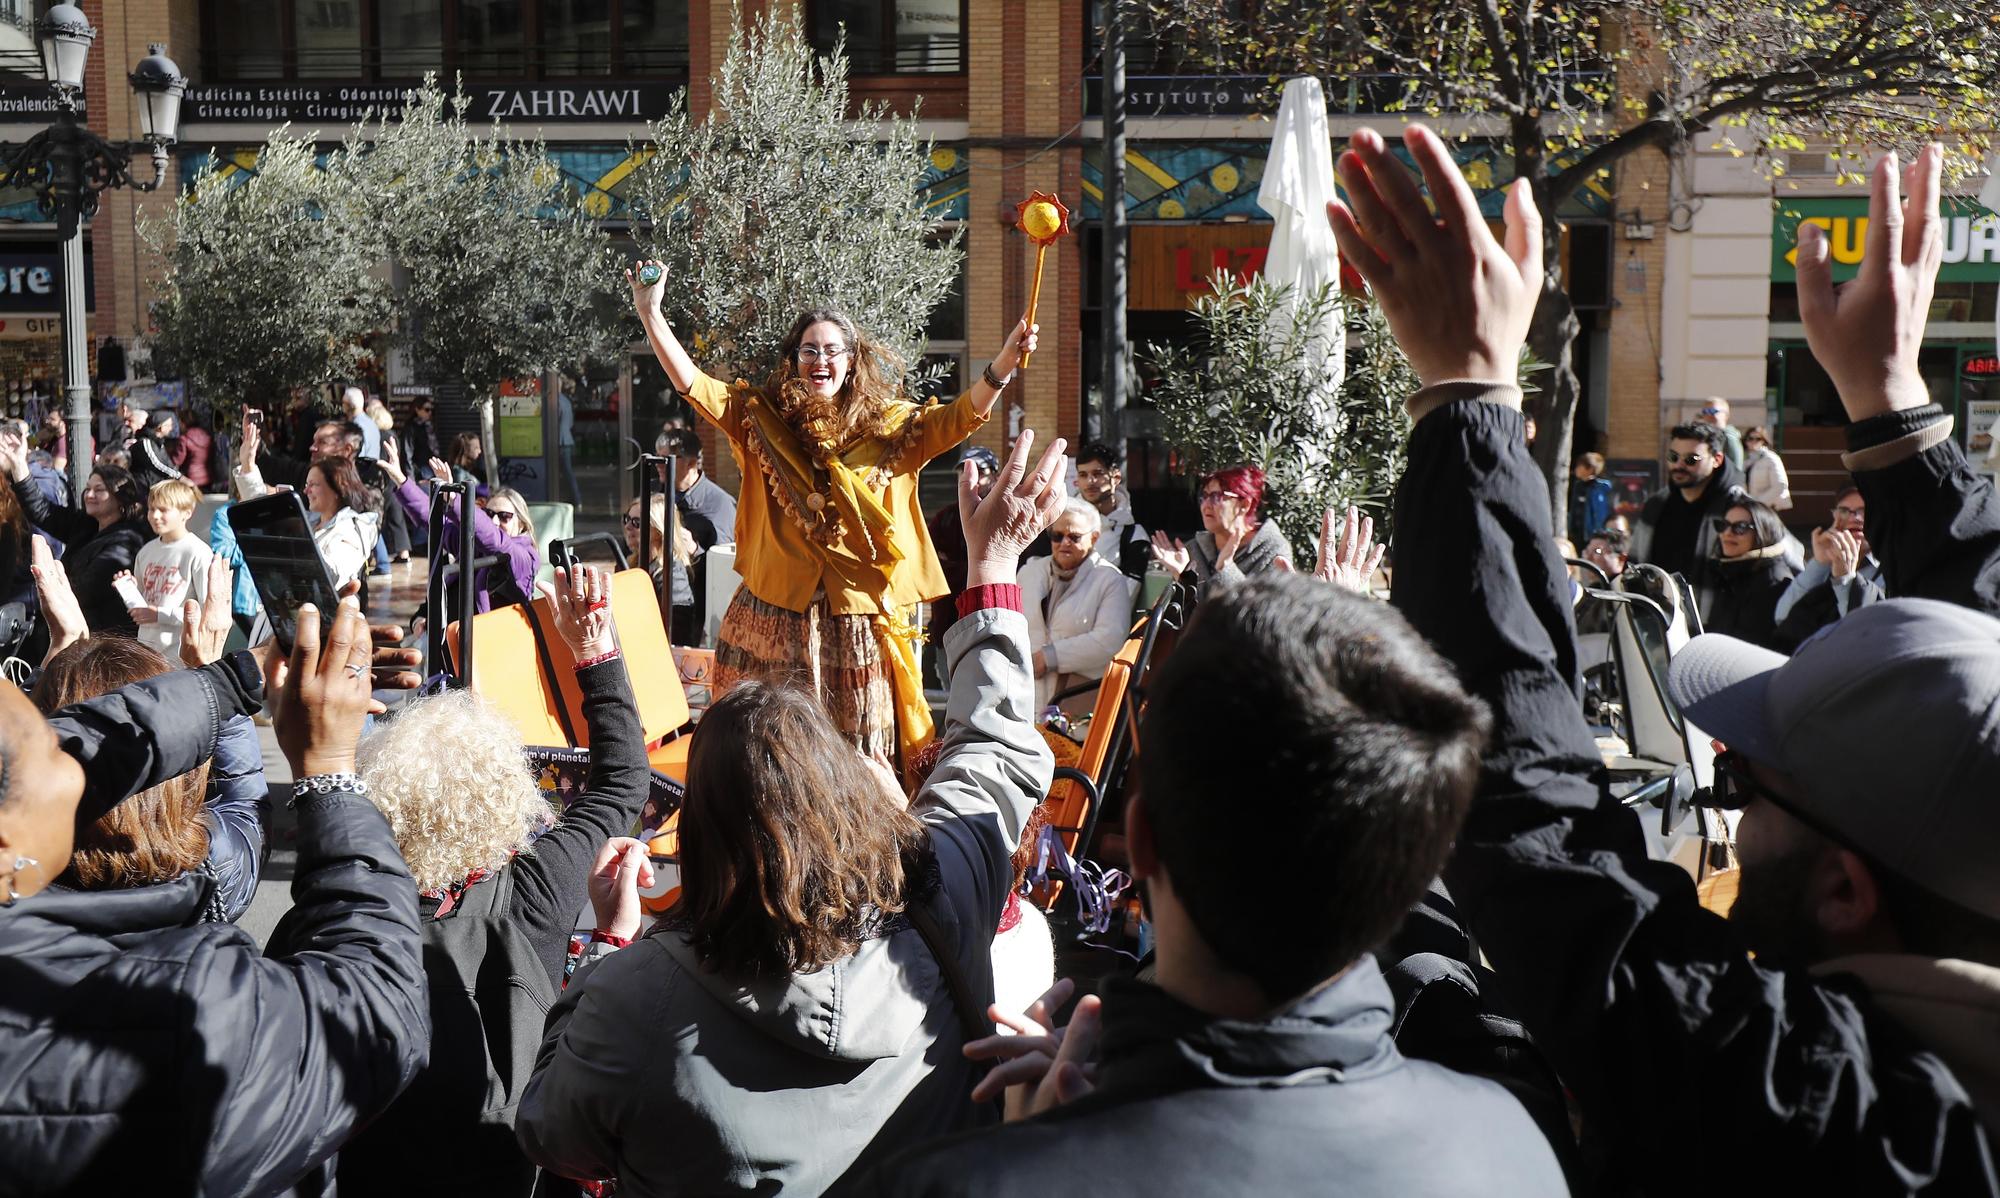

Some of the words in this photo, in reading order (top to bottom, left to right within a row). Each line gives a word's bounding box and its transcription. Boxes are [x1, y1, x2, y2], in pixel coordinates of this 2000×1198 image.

[185, 88, 252, 101] Medicina
[259, 87, 320, 101] Estética
[340, 88, 417, 103] Odontolog
[487, 89, 641, 116] ZAHRAWI
[1130, 92, 1230, 104] STITUTO
[26, 319, 56, 333] GIF
[1967, 357, 2000, 374] ABIE
[551, 752, 591, 764] planeta!
